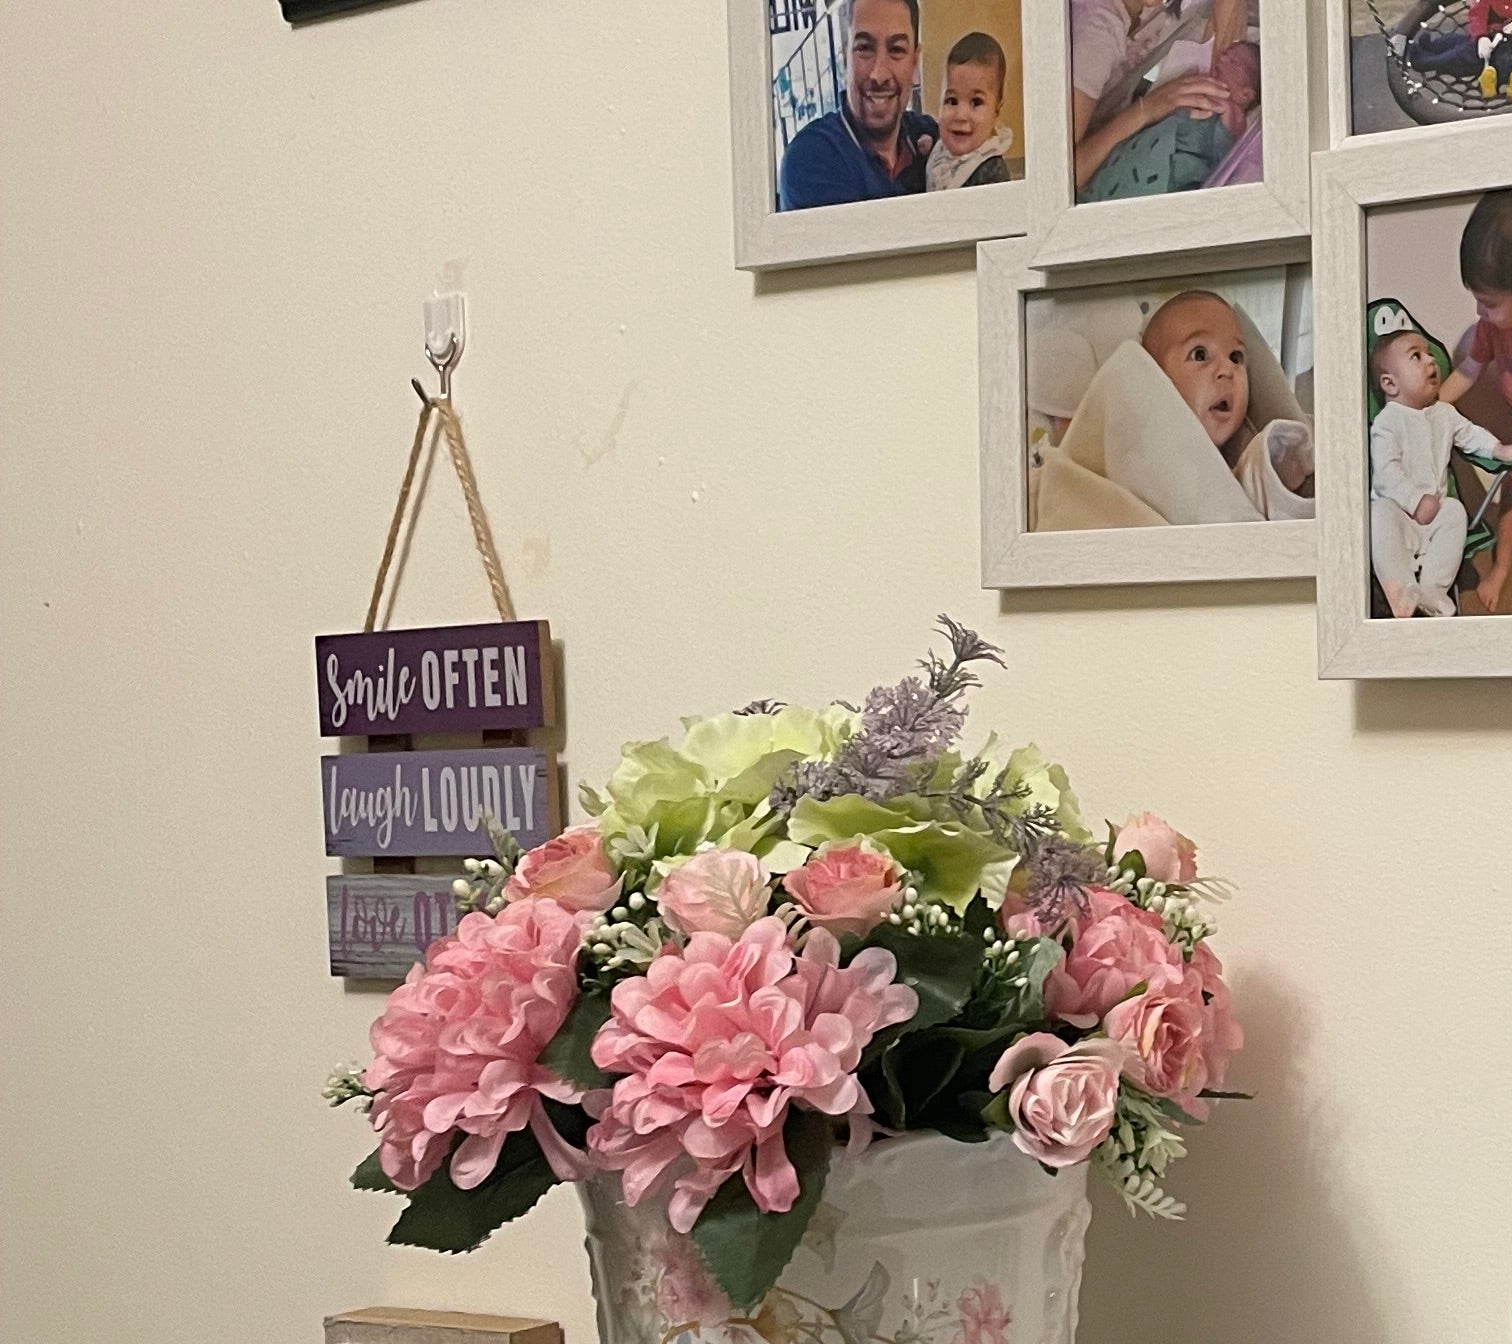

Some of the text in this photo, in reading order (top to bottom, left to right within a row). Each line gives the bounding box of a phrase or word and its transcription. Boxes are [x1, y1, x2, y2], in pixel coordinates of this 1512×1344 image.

[420, 644, 528, 712] OFTEN
[329, 763, 537, 850] laugh LOUDLY
